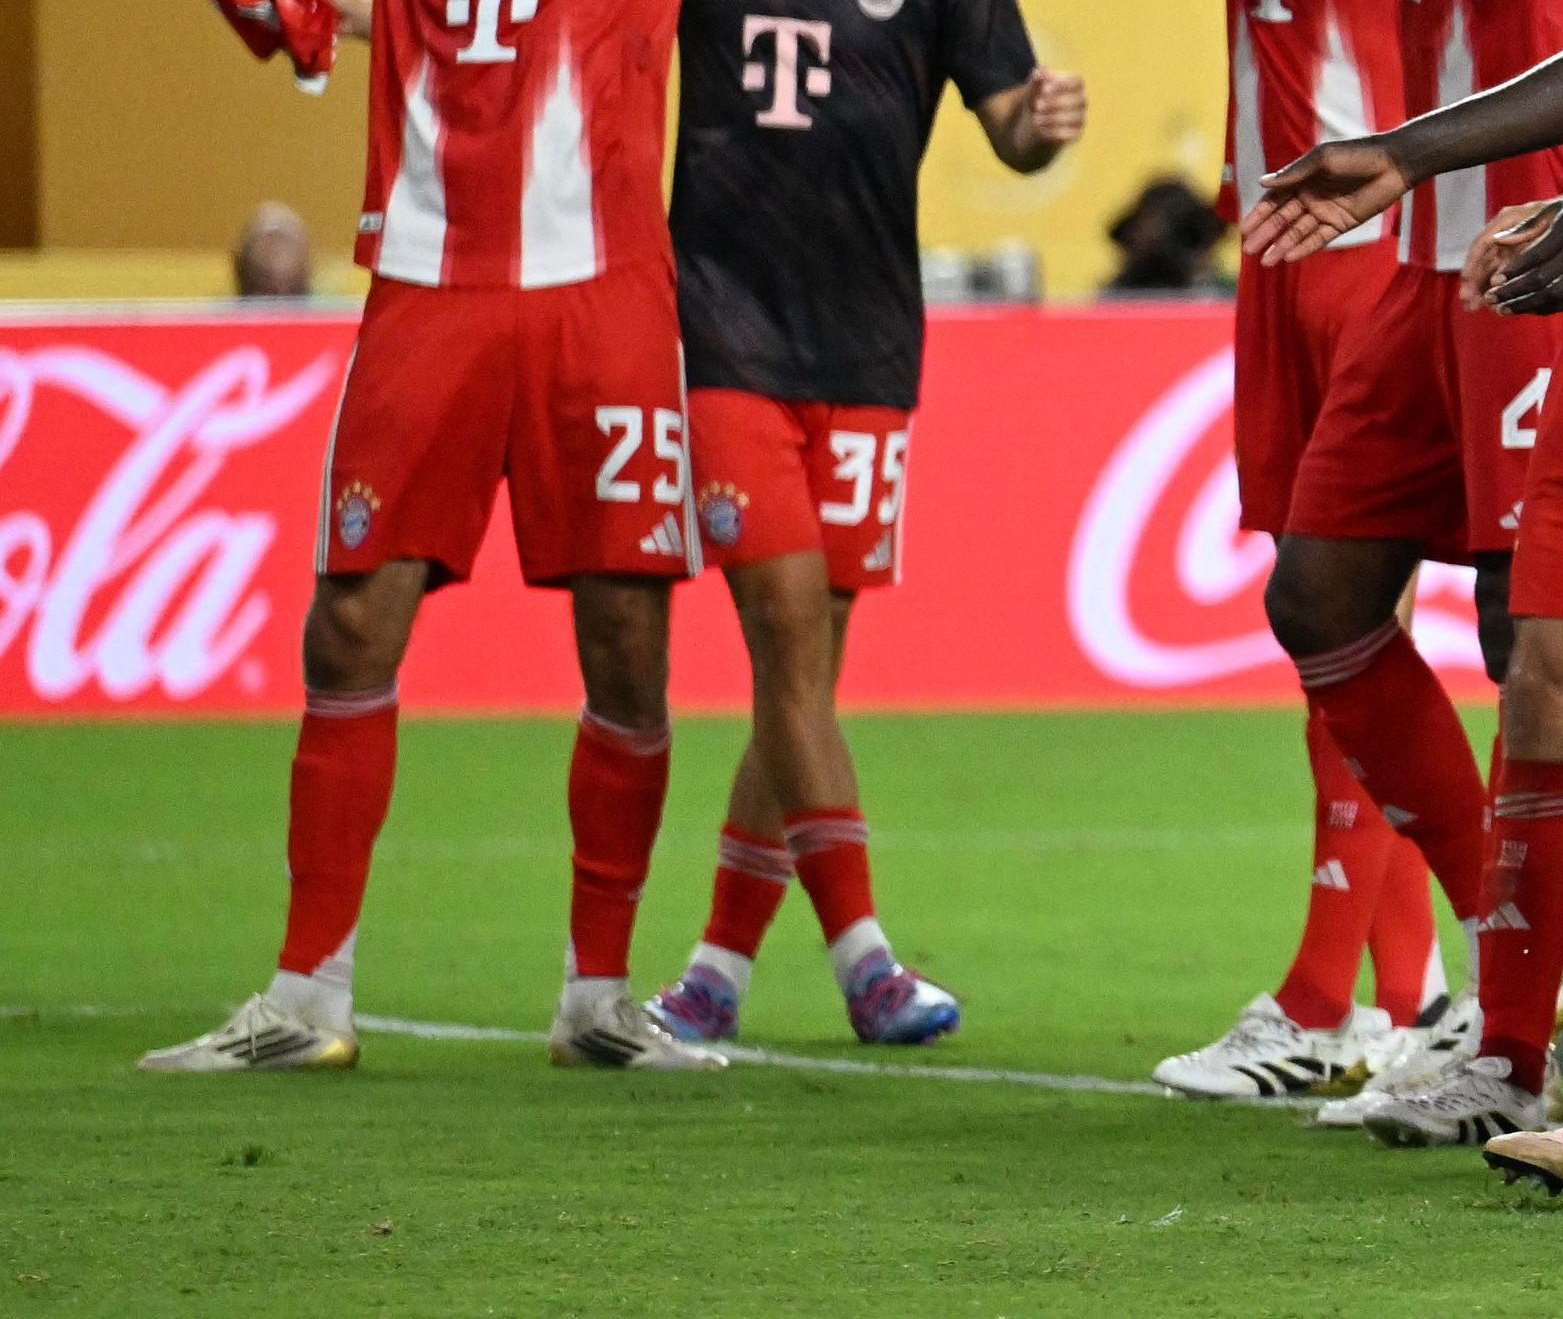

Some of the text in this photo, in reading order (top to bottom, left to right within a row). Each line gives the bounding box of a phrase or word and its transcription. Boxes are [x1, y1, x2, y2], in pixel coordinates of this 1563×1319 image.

[741, 14, 833, 130] T
[594, 404, 685, 504] 25
[820, 429, 908, 526] 35
